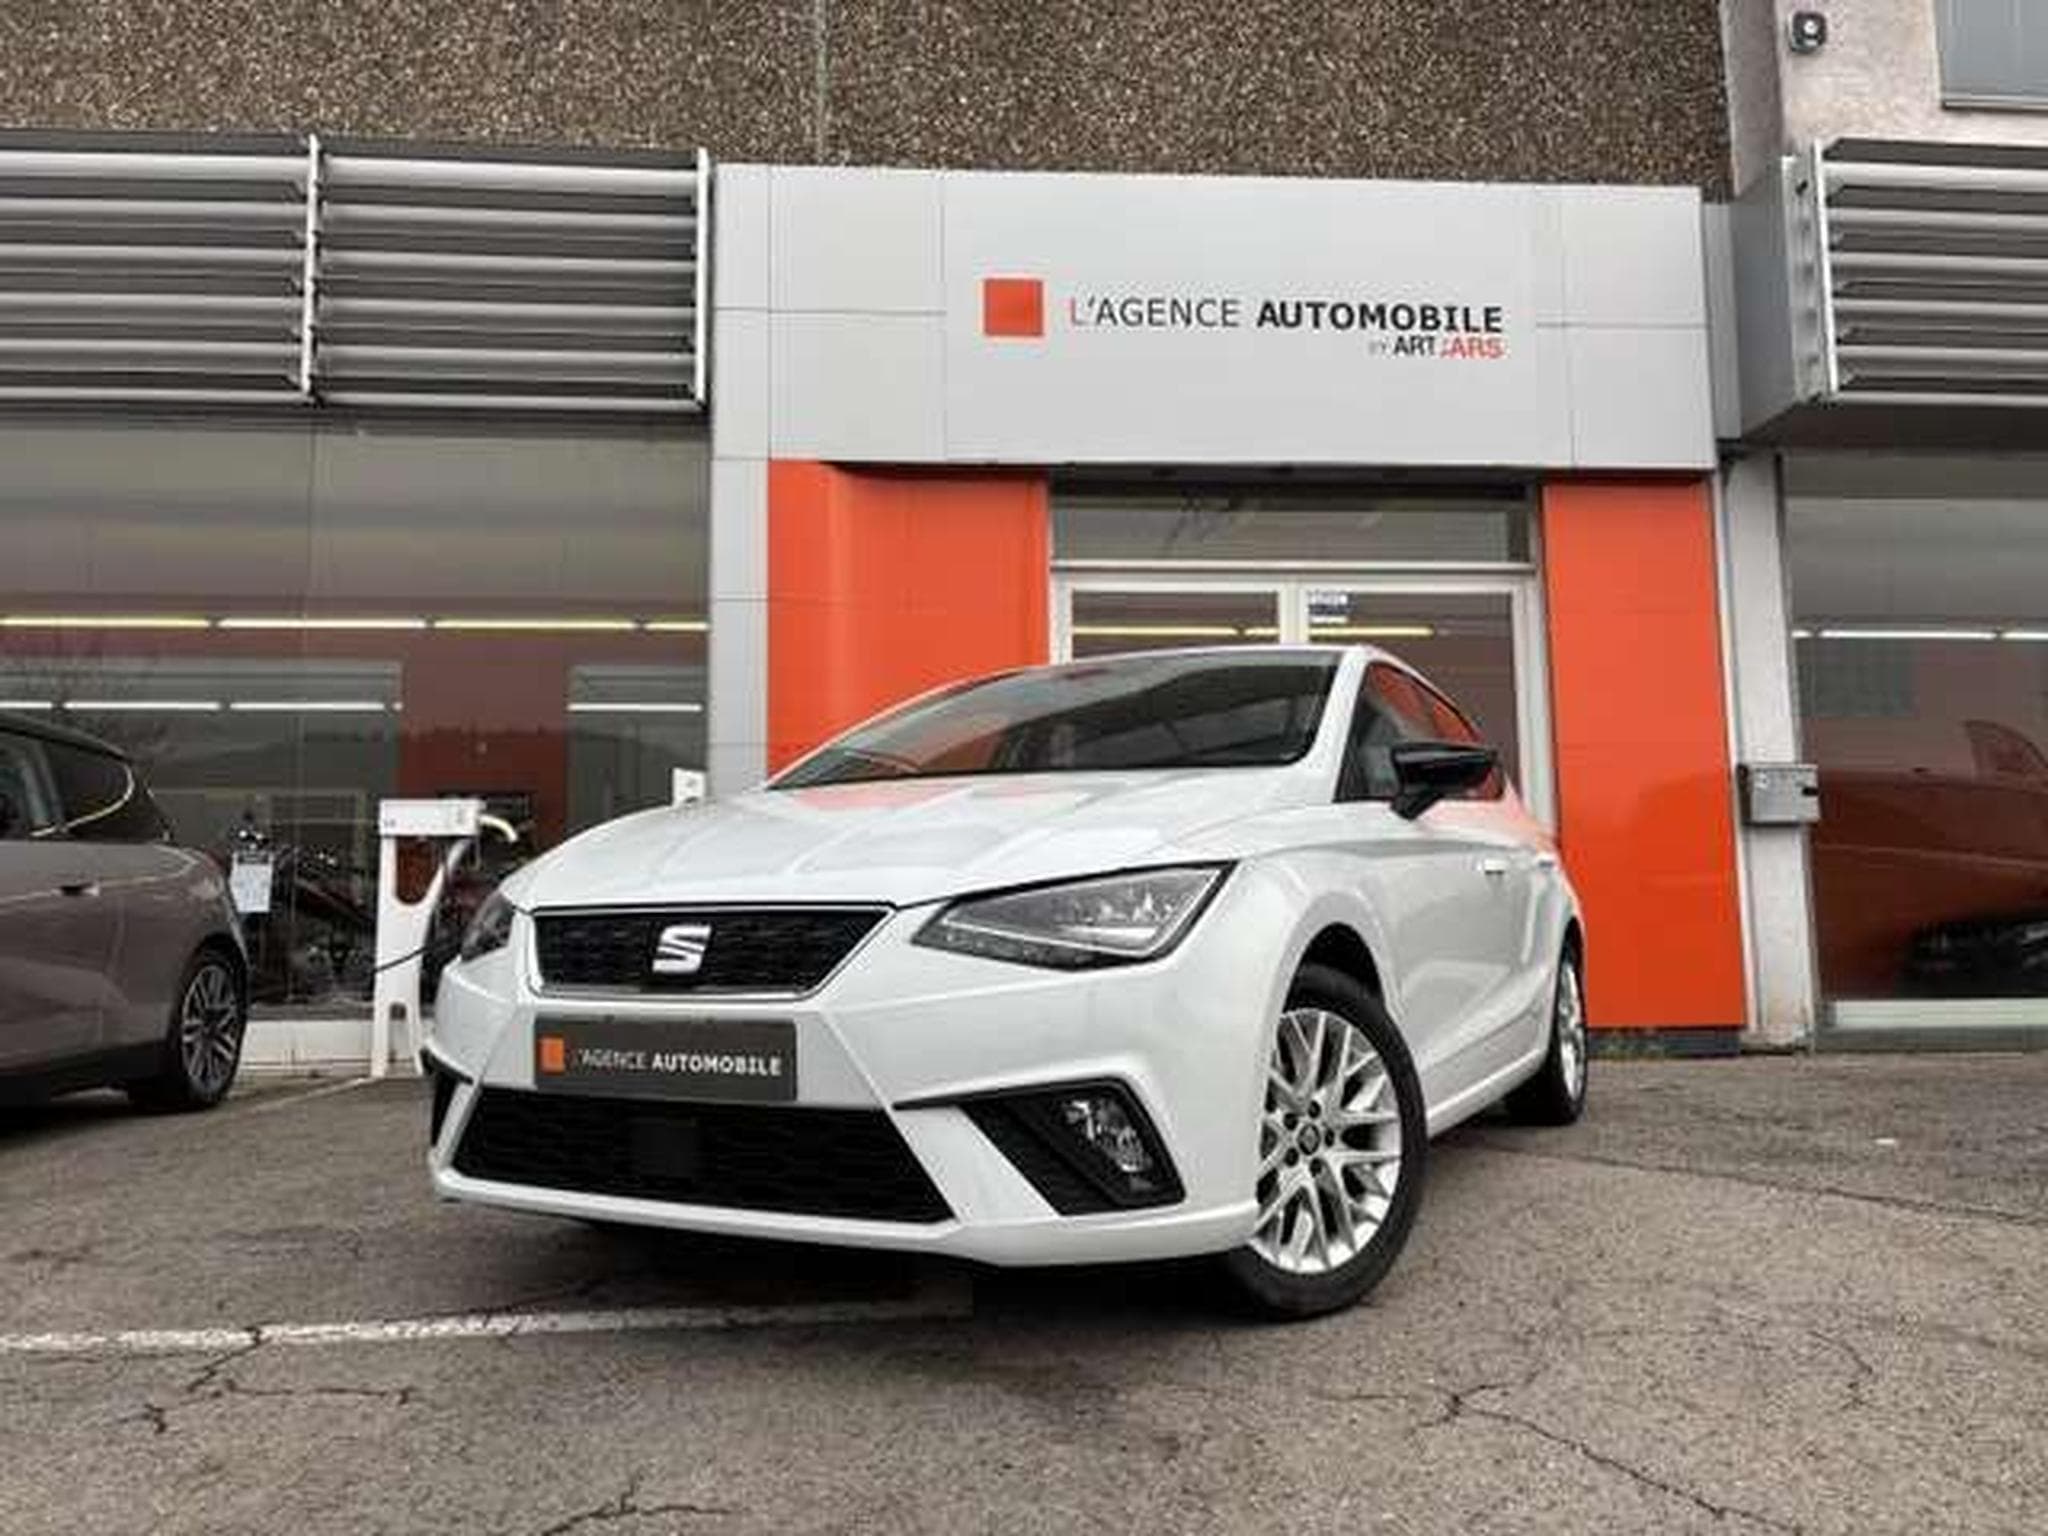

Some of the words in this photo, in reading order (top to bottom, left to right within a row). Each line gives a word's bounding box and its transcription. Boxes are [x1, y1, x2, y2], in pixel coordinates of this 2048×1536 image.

[1070, 296, 1239, 328] L'AGENCE
[1256, 301, 1503, 333] AUTOMOBILE
[1393, 335, 1435, 356] ART
[651, 1052, 782, 1077] AUTOMOBILE
